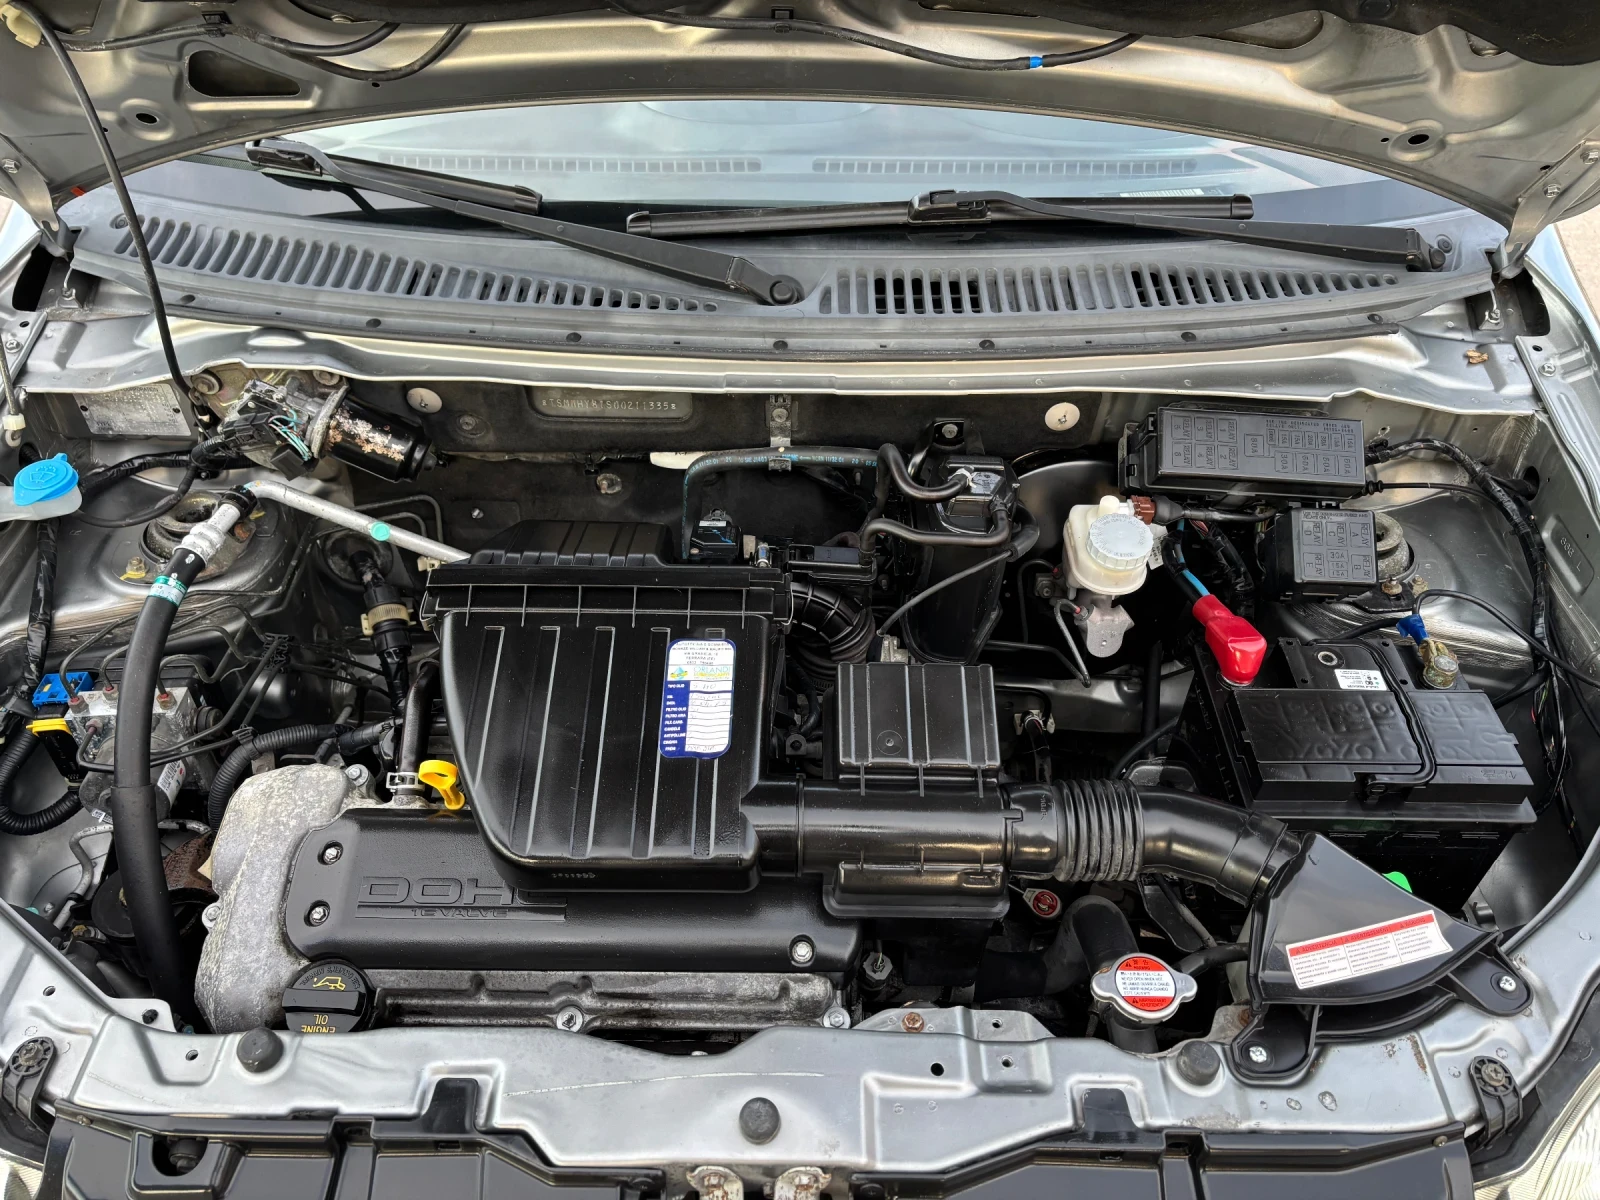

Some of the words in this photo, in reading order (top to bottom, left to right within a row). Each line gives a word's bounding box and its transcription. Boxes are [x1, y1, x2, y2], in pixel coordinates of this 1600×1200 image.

[1228, 421, 1236, 440] RELAY
[1228, 447, 1236, 467] RELAY
[1313, 521, 1321, 544] RELAY
[1337, 523, 1346, 546] RELAY
[1361, 523, 1369, 547] RELAY
[1363, 556, 1371, 578] RELAY
[1350, 927, 1390, 942] AVERTISSEMENT
[1302, 940, 1337, 953] ADVERTENCIA
[301, 1025, 336, 1033] ENGINE
[313, 1014, 329, 1025] OIL
